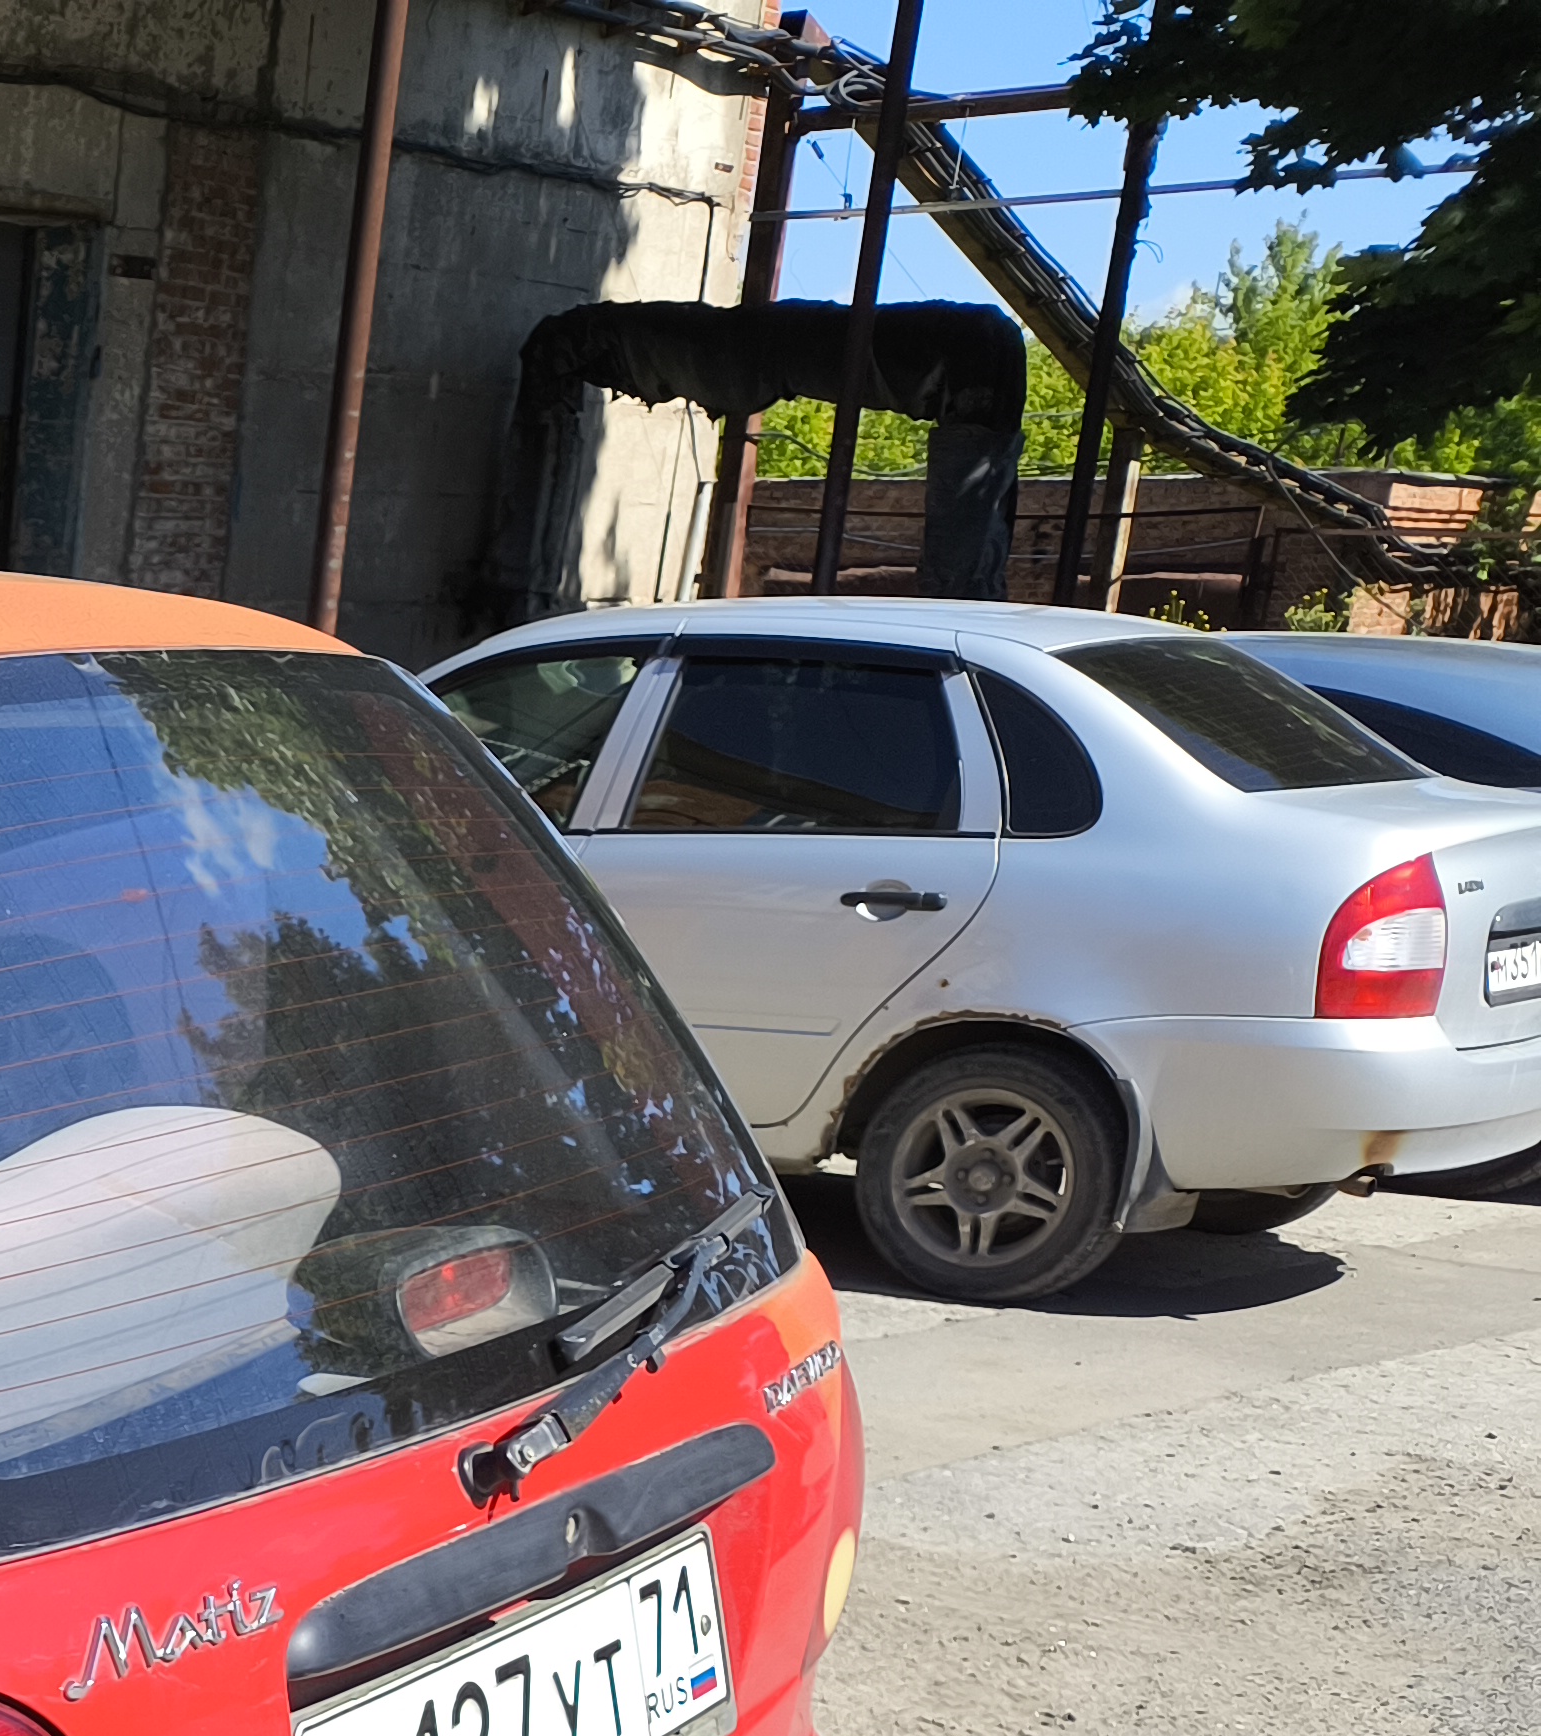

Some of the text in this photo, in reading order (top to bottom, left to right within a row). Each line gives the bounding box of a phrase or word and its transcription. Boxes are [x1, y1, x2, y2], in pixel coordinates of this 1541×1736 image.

[763, 1340, 842, 1413] DAEWOO
[64, 1579, 285, 1702] Matiz
[639, 1565, 699, 1678] 71
[647, 1676, 688, 1721] RUS
